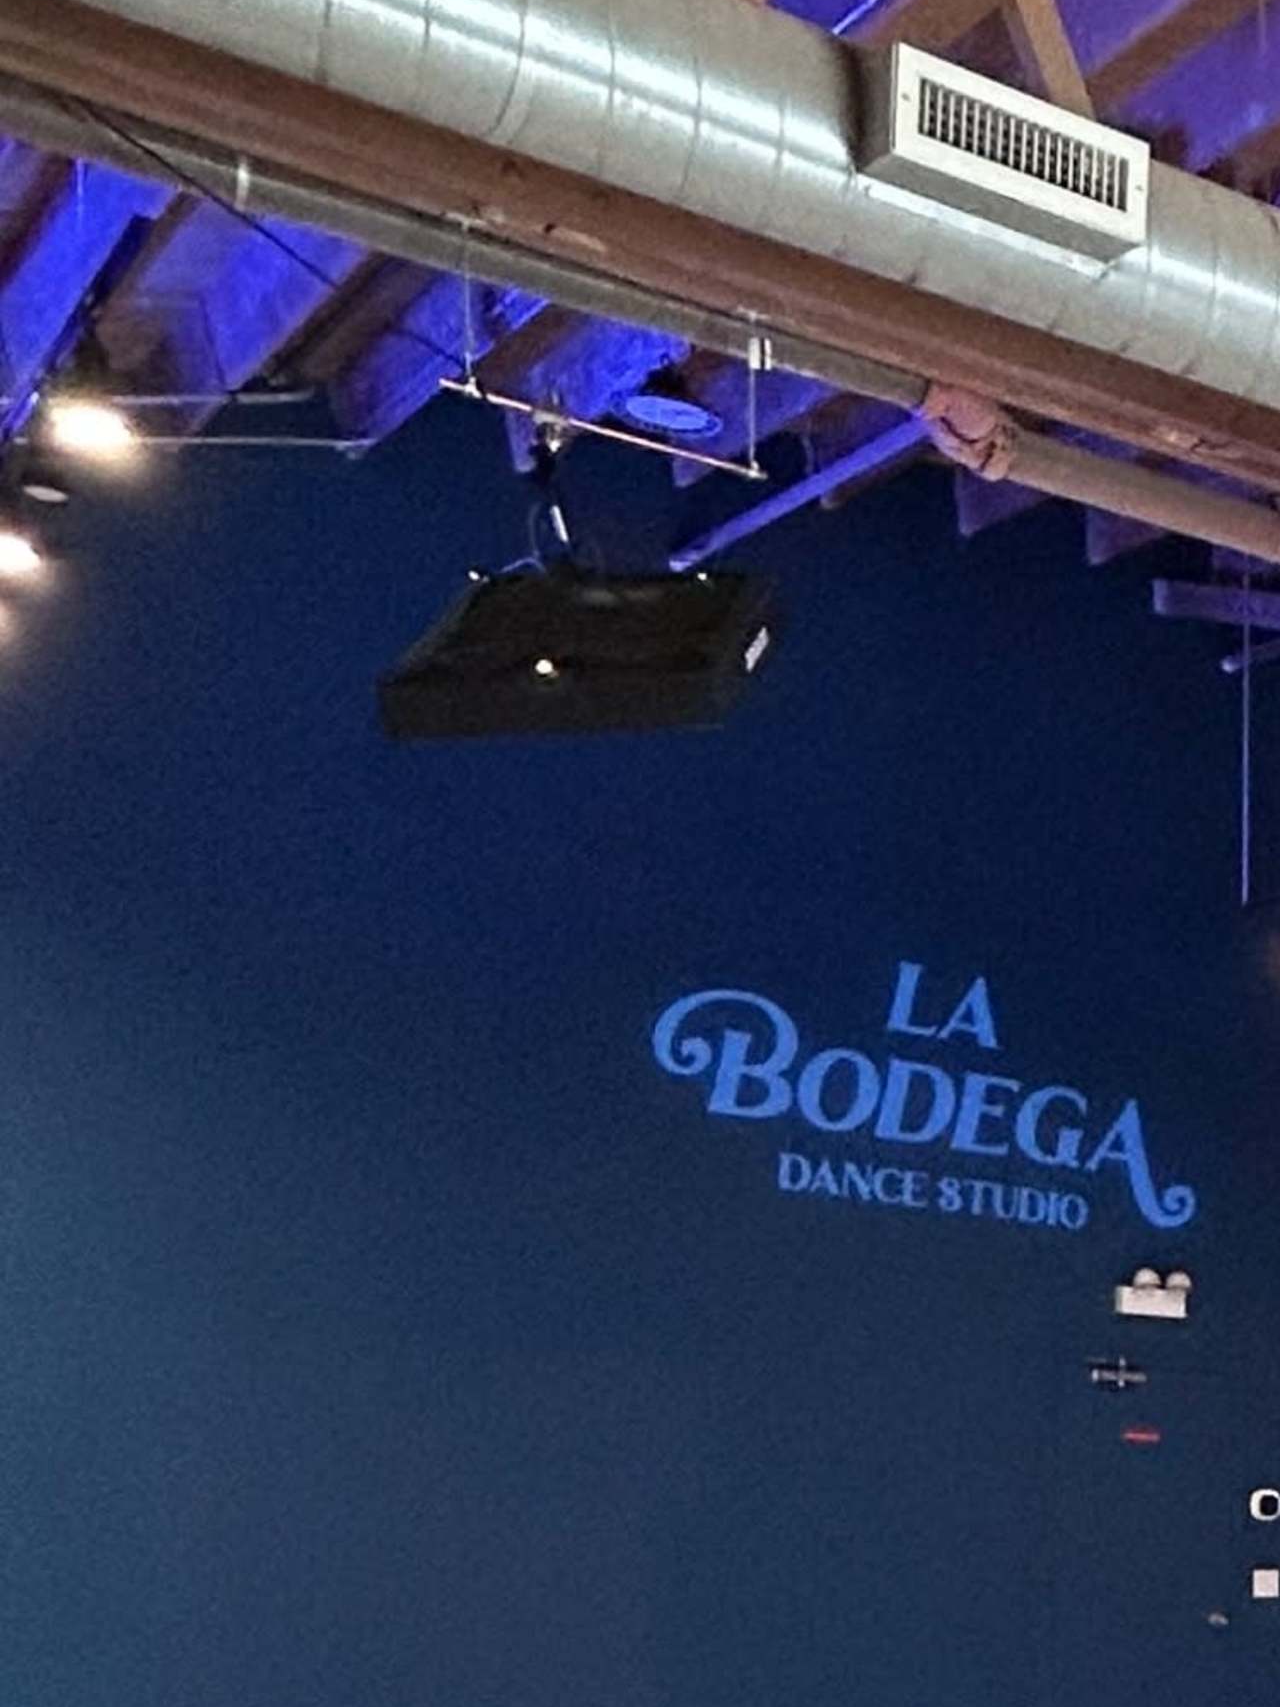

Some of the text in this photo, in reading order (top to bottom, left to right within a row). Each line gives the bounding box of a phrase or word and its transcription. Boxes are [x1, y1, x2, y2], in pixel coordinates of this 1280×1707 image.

[886, 961, 998, 1049] LA
[651, 989, 1196, 1229] BODEGA
[777, 1152, 1089, 1230] DANCE STUDIO
